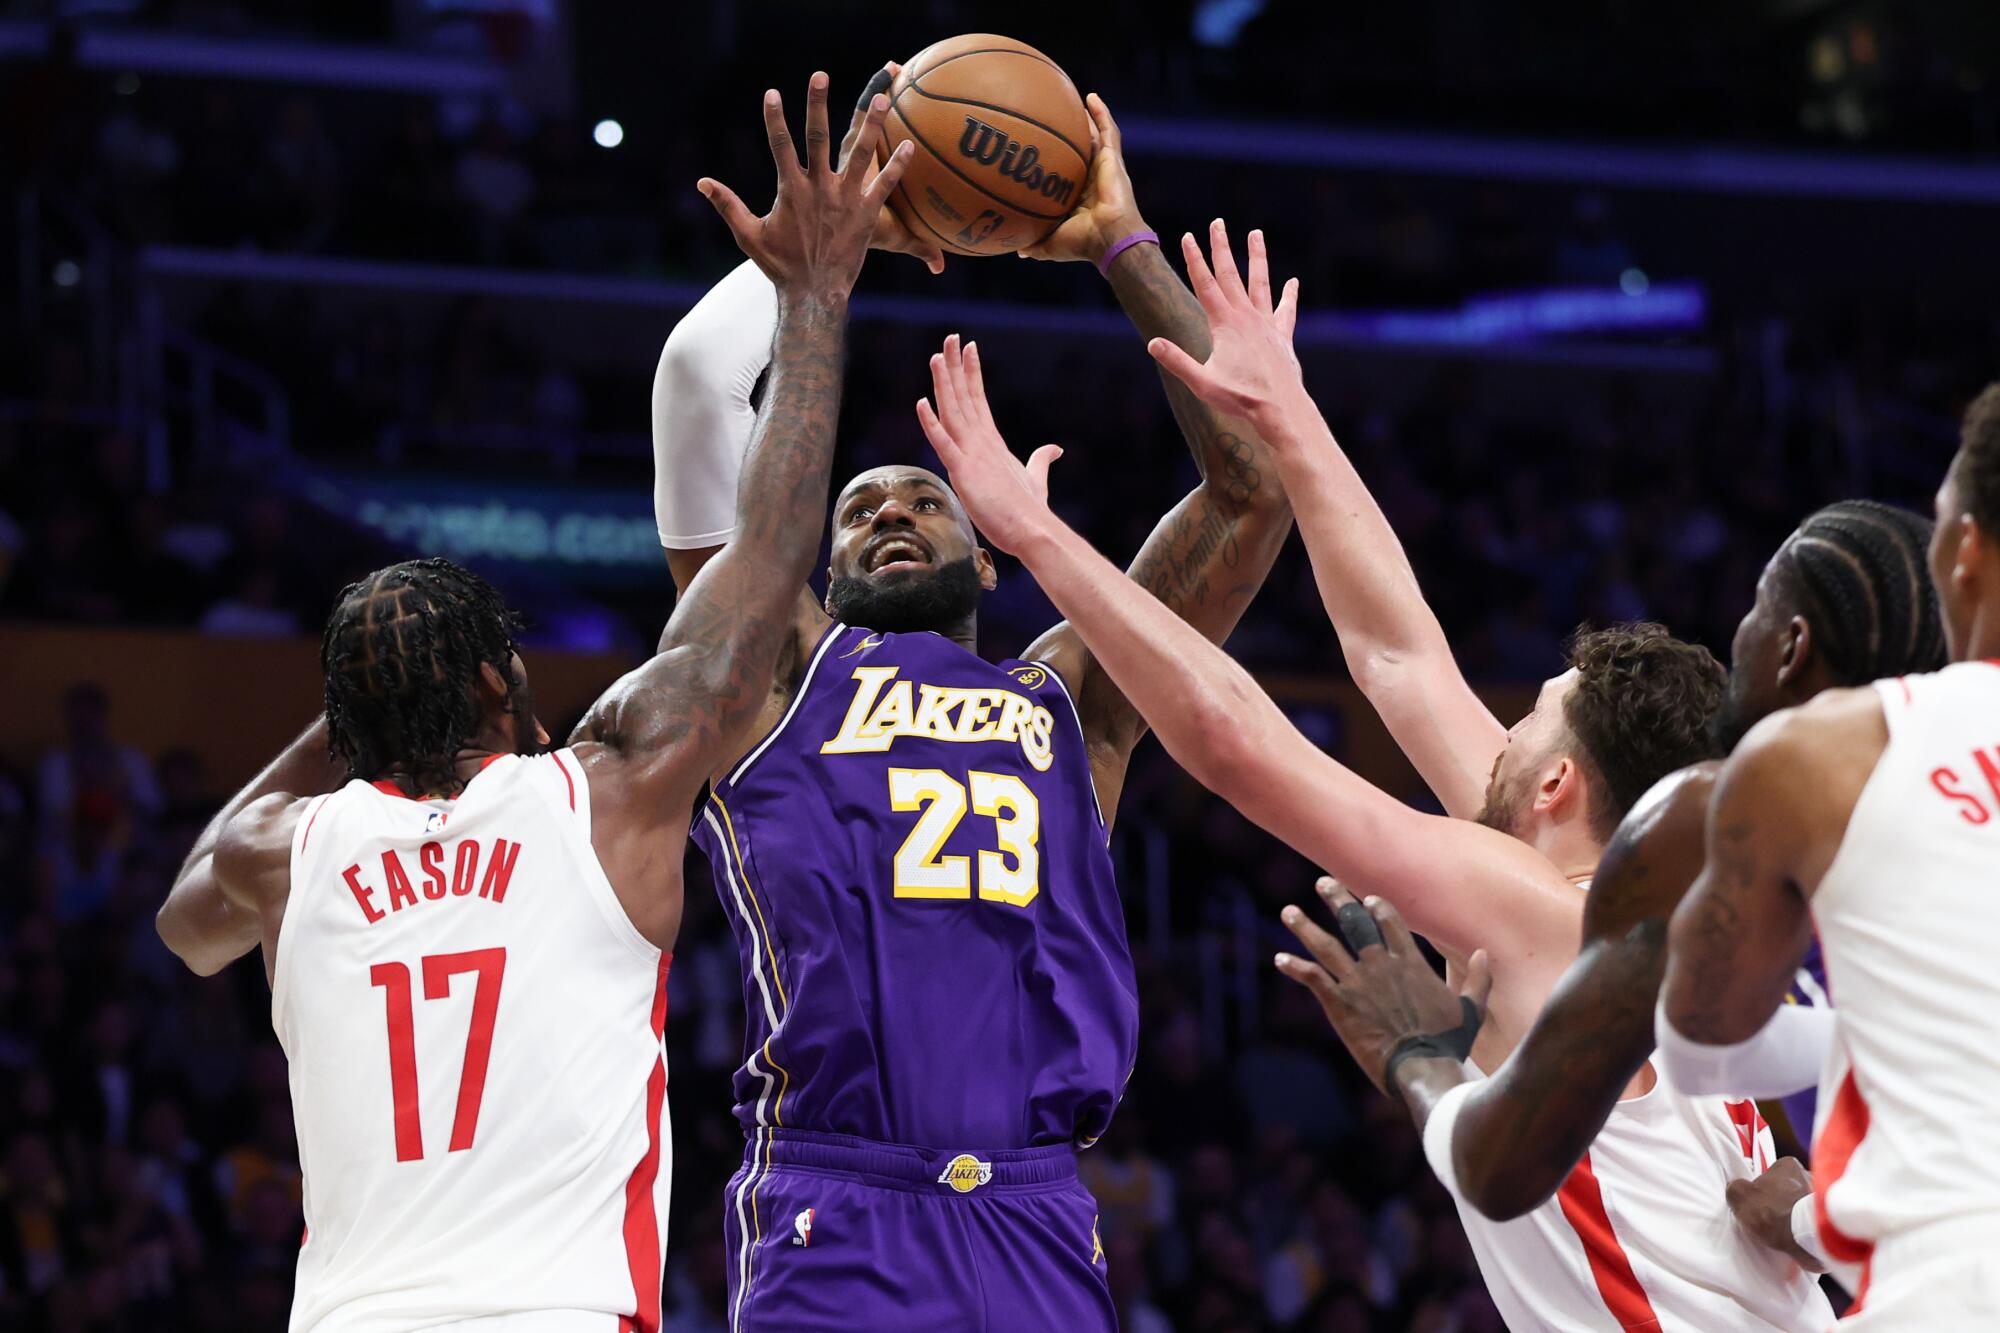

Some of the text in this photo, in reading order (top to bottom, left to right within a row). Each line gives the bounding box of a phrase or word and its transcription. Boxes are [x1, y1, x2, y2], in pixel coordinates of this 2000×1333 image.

[960, 115, 1074, 206] Wilson
[820, 666, 1055, 772] LAKERS
[342, 838, 521, 924] EASON
[887, 767, 1040, 908] 23
[370, 946, 507, 1162] 17
